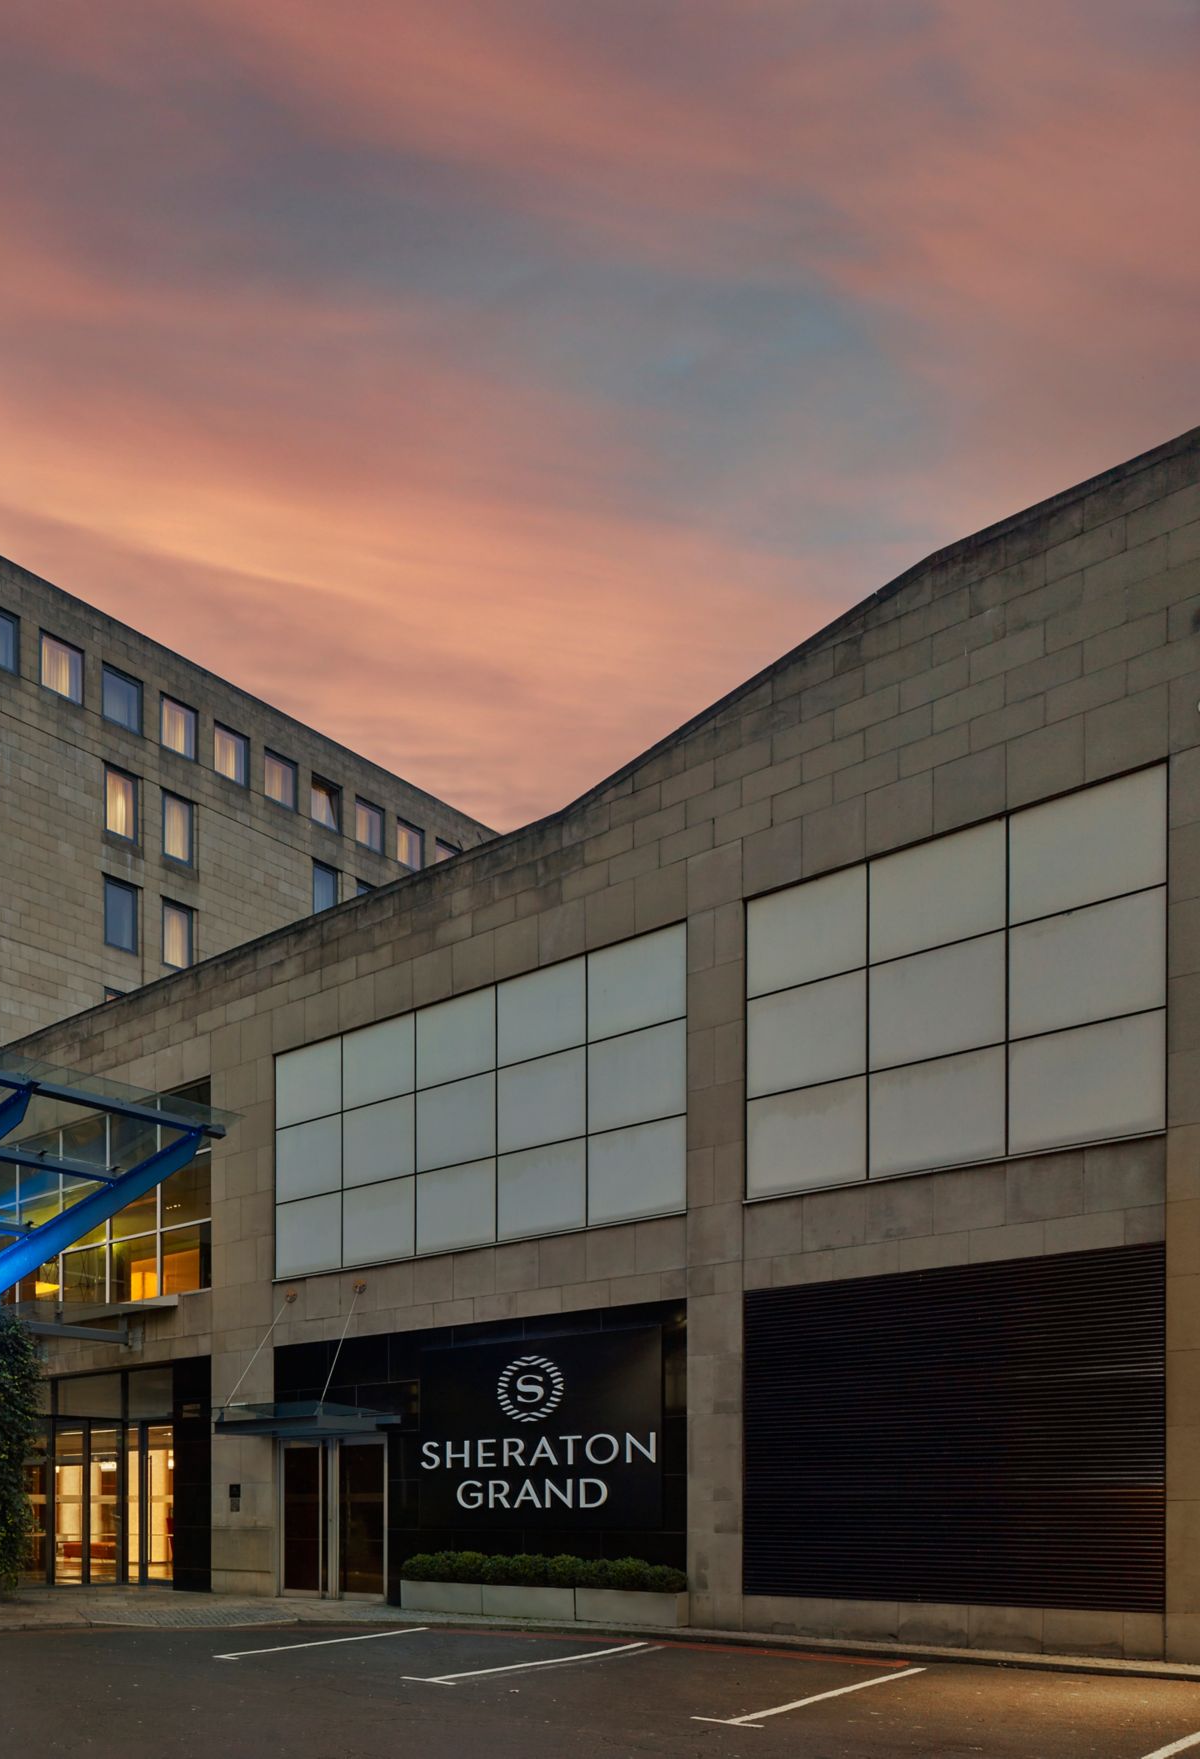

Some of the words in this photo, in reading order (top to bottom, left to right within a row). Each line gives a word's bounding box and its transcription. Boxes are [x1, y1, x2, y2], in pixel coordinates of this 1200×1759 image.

[516, 1375, 544, 1403] S
[420, 1431, 656, 1470] SHERATON
[456, 1478, 608, 1509] GRAND
